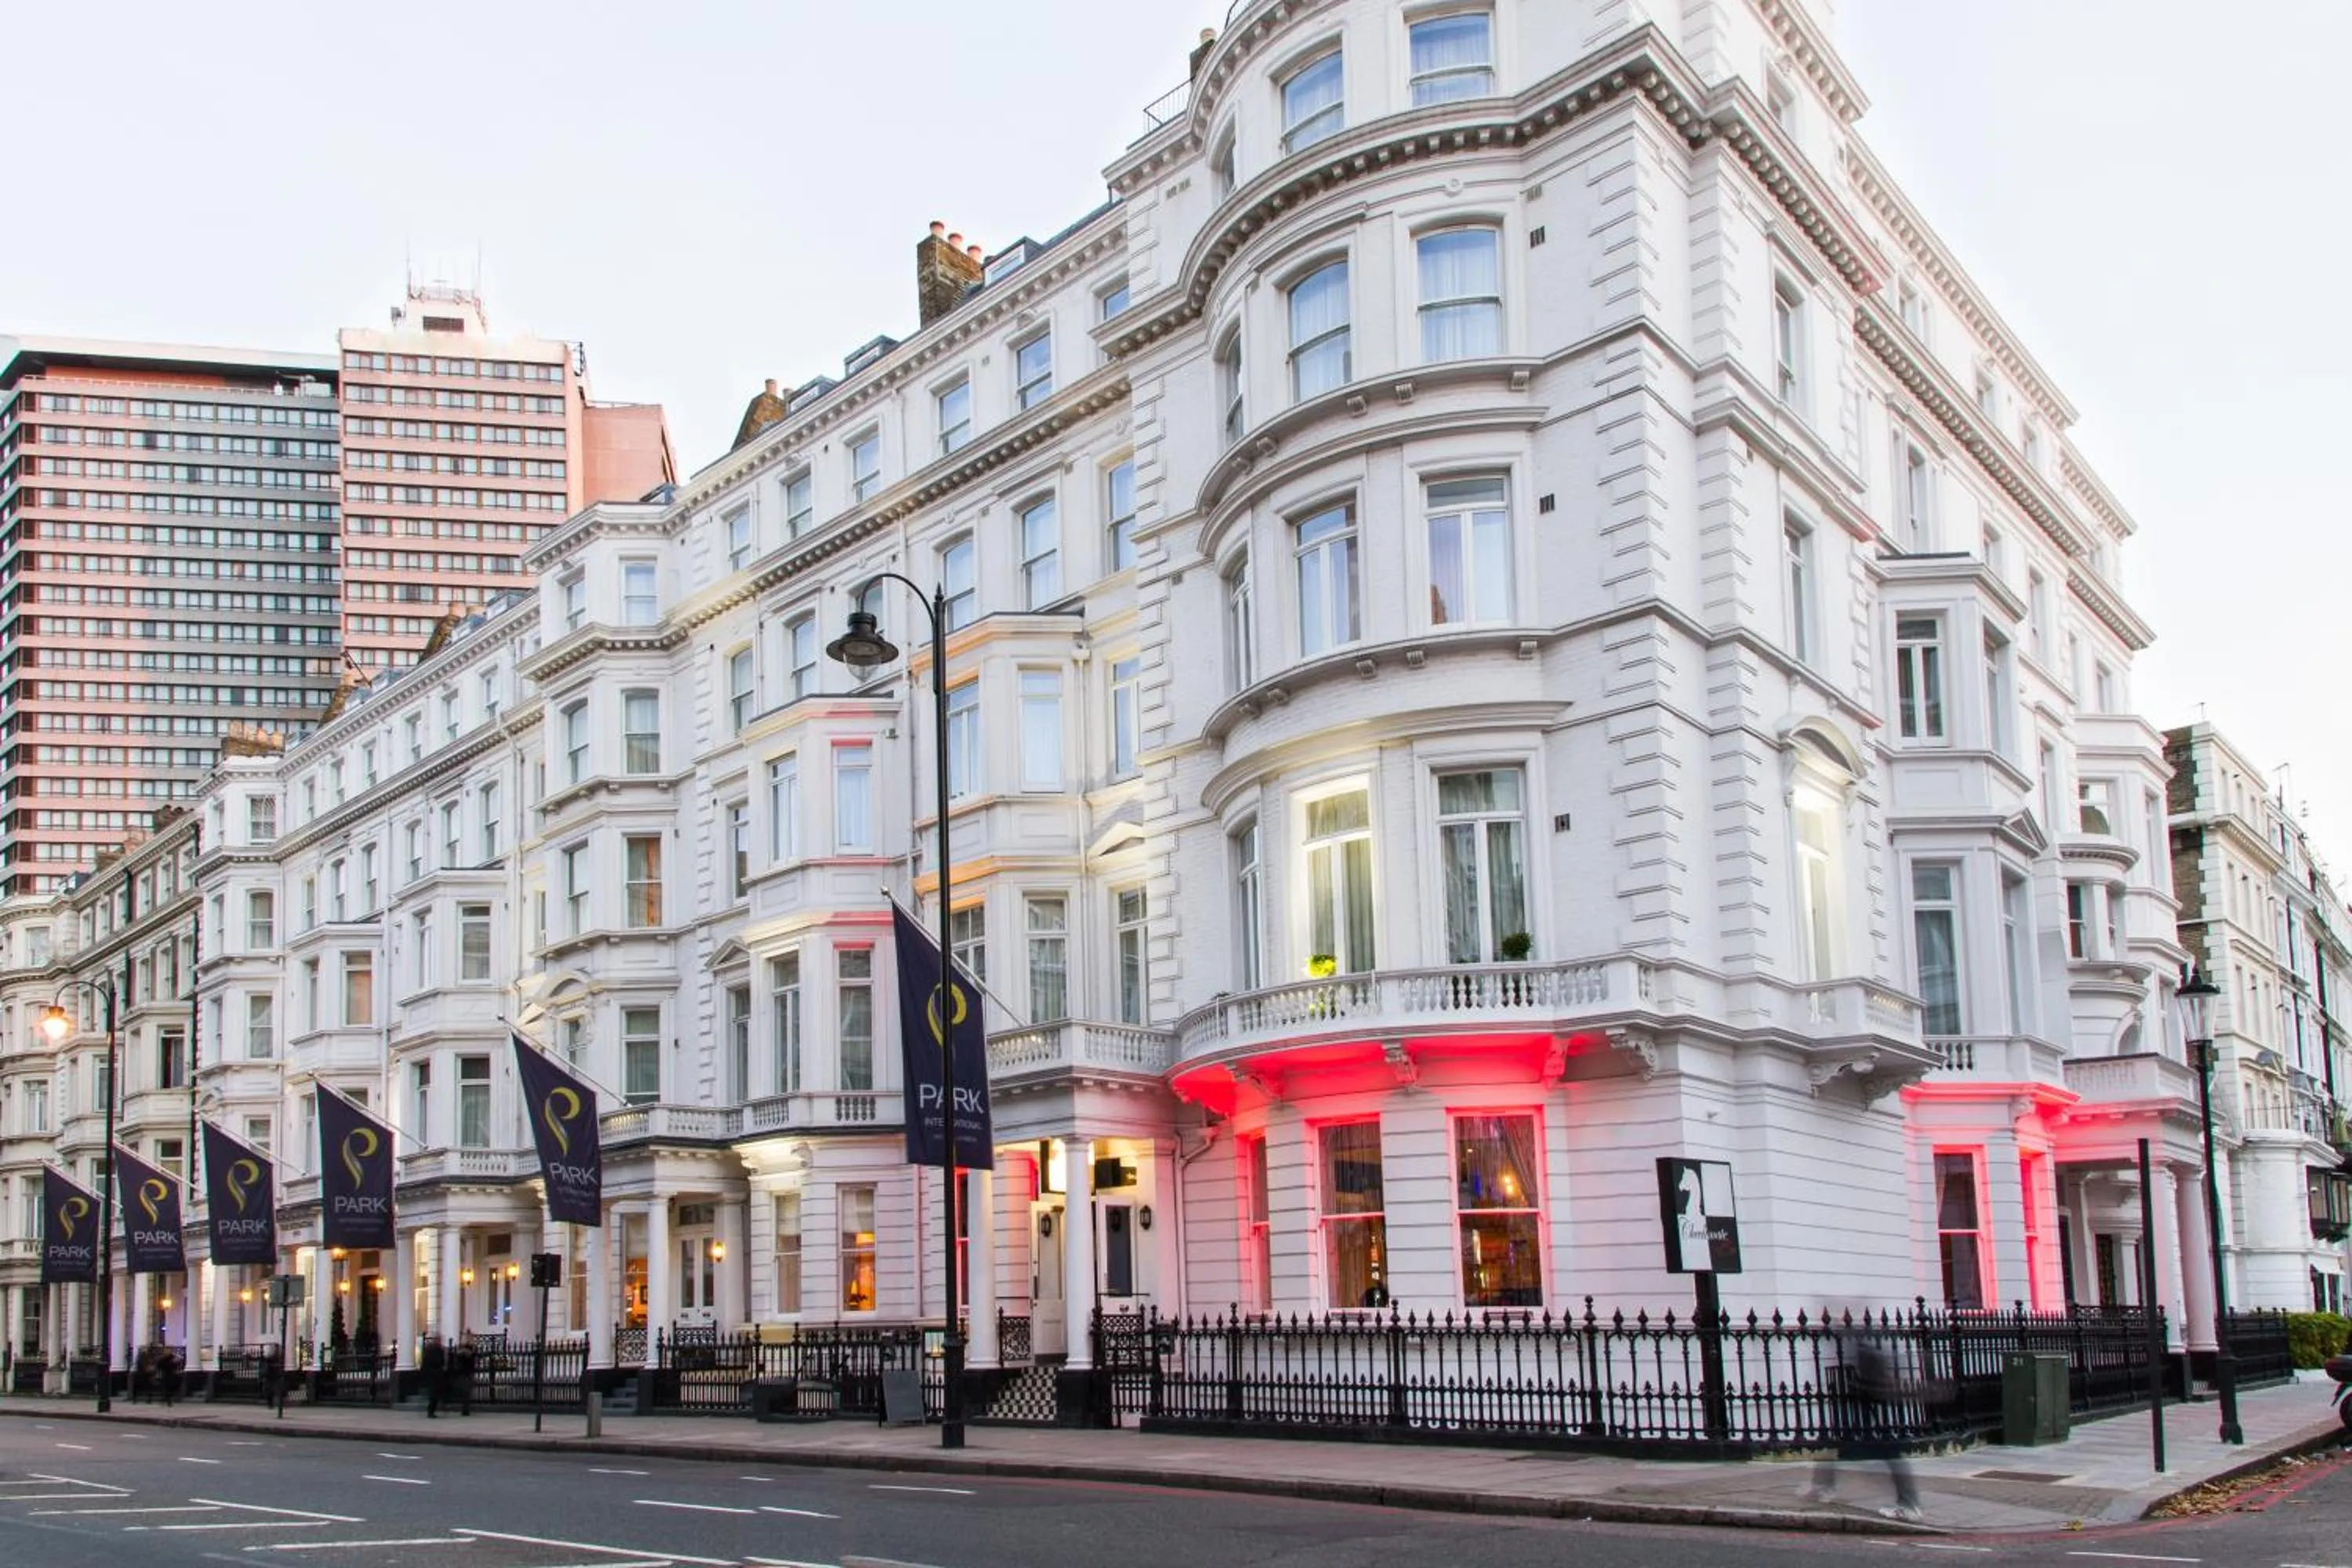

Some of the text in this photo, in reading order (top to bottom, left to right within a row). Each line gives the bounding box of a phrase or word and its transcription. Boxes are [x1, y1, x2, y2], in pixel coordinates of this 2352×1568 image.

[919, 1083, 985, 1114] PARK
[924, 1116, 985, 1131] INTEATIONAL
[550, 1162, 598, 1186] PARK
[334, 1195, 388, 1214] PARK
[218, 1218, 269, 1236] PARK
[133, 1230, 180, 1246] PARK
[49, 1245, 92, 1259] PARK
